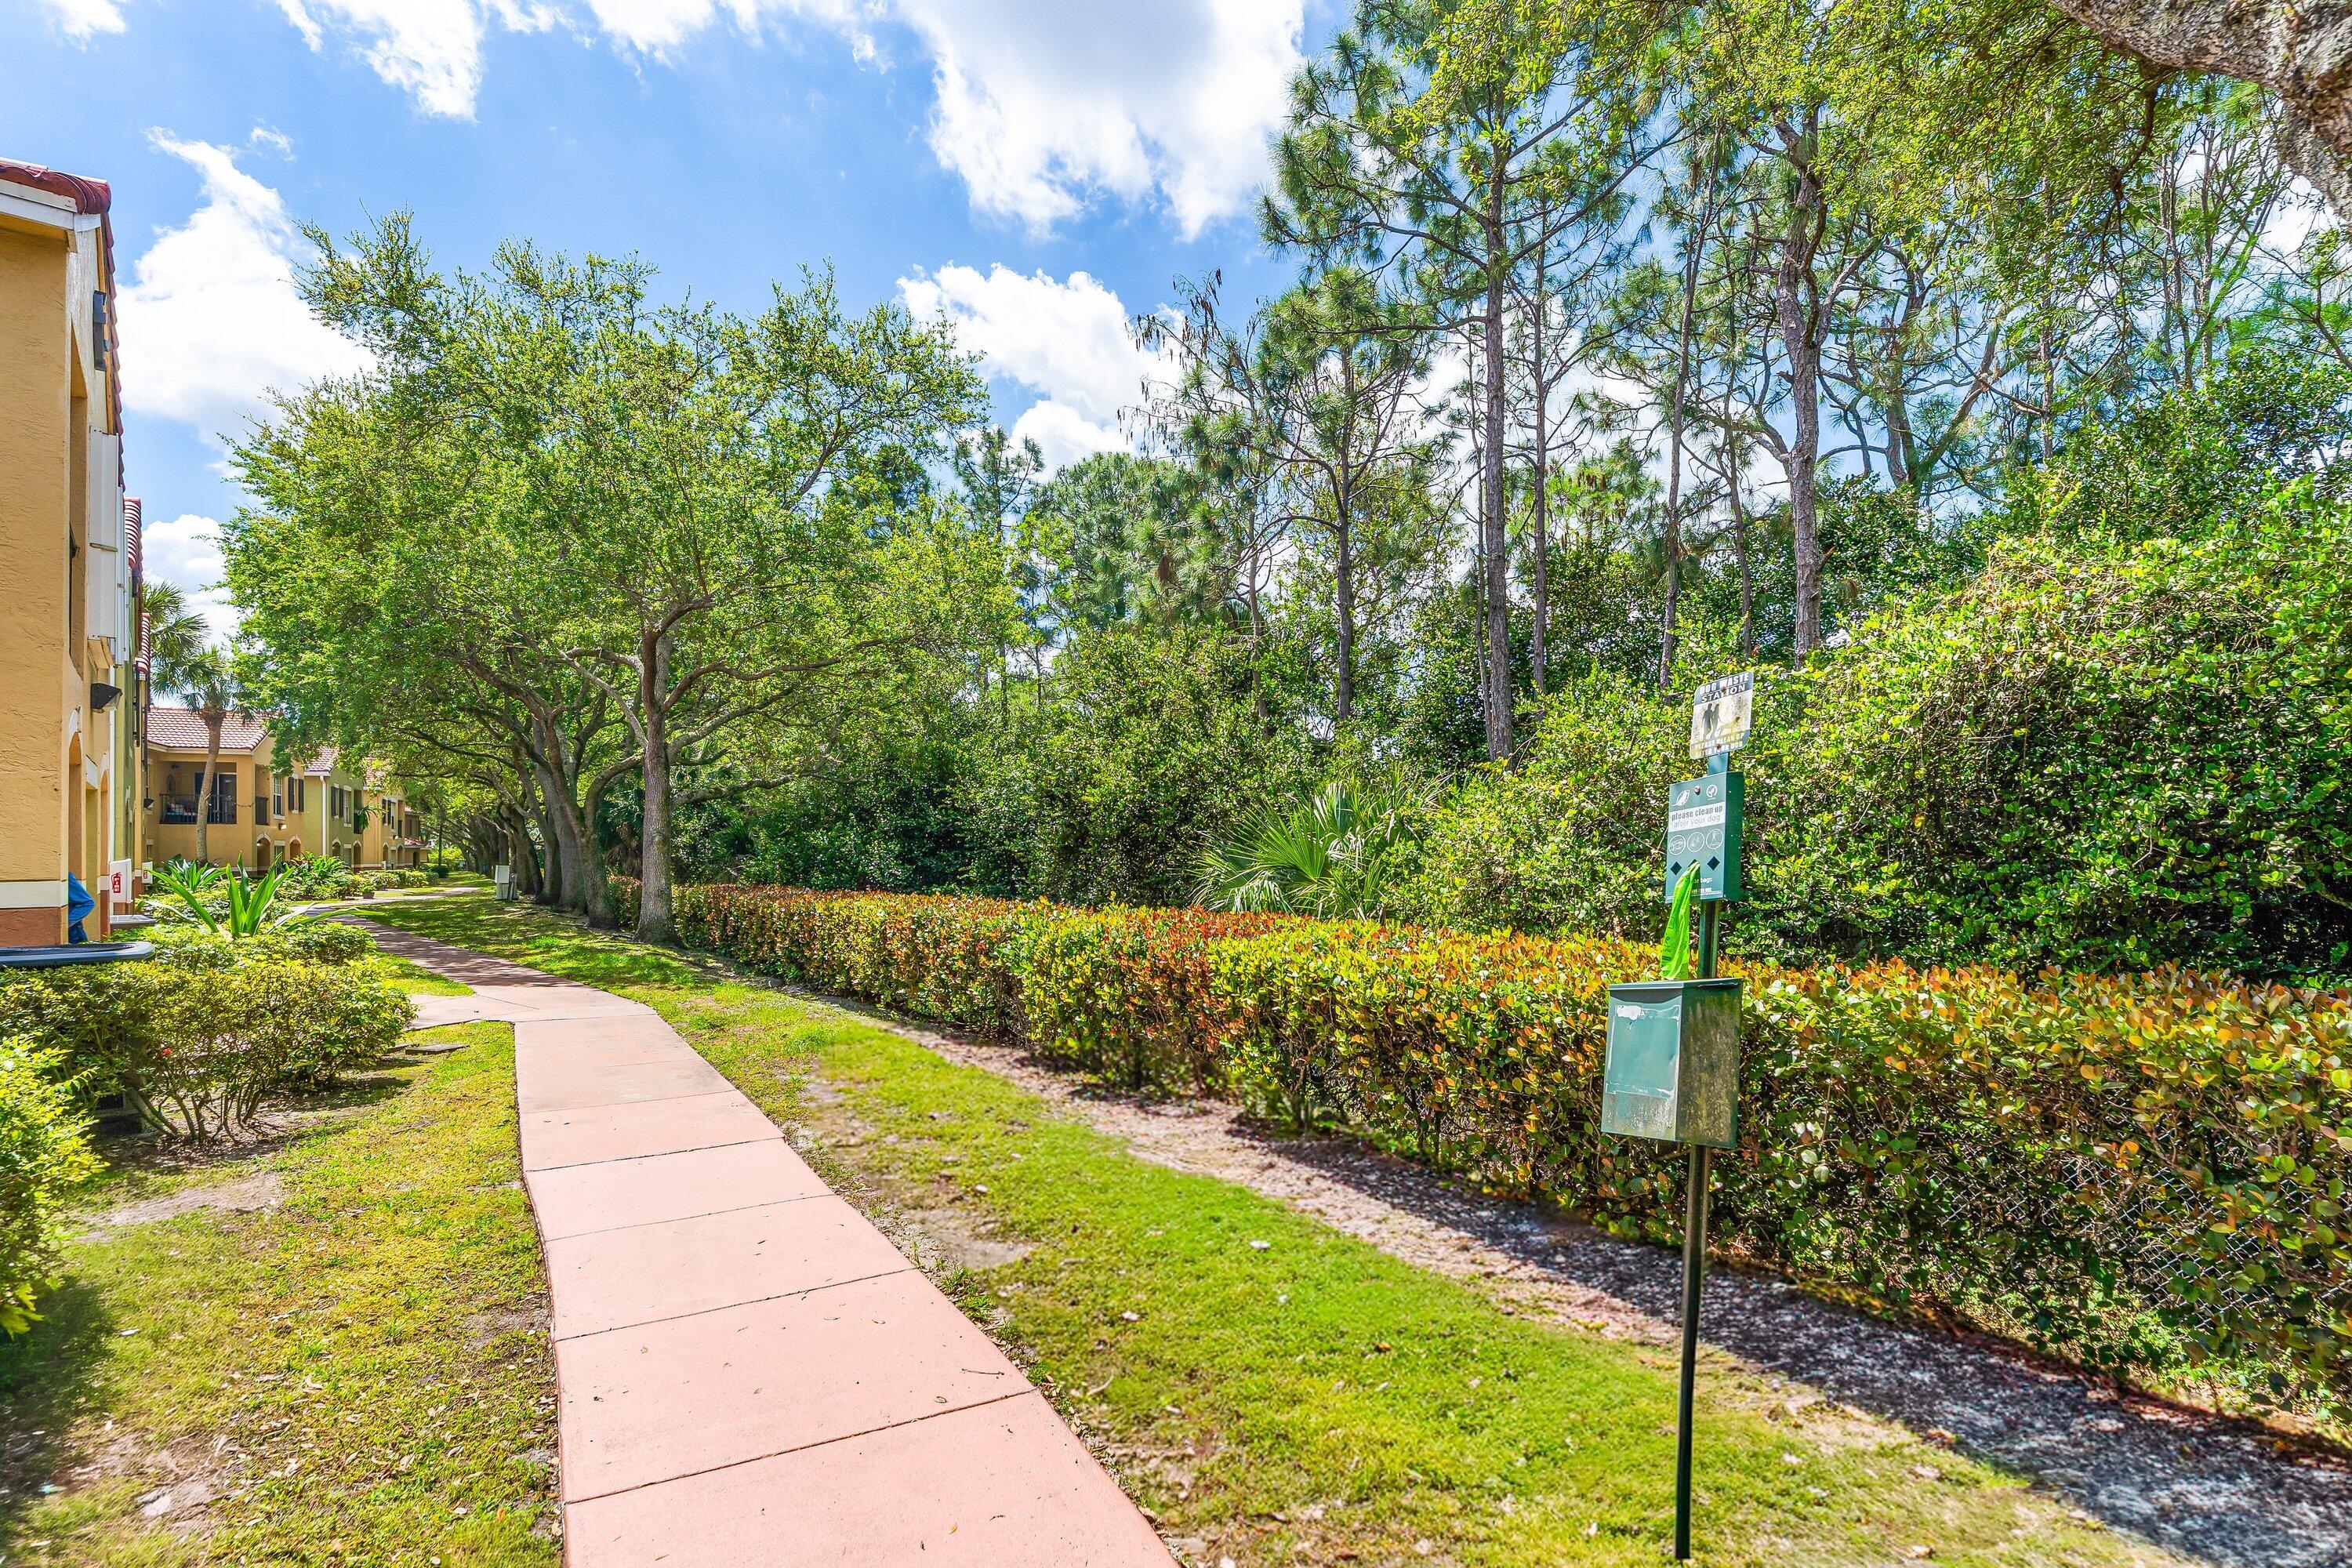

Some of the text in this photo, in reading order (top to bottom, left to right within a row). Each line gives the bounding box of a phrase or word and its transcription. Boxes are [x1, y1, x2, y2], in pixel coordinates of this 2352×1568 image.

[1719, 673, 1749, 688] WASTE
[1671, 805, 1723, 821] please clean up
[1673, 819, 1689, 828] after
[1707, 814, 1721, 823] dog
